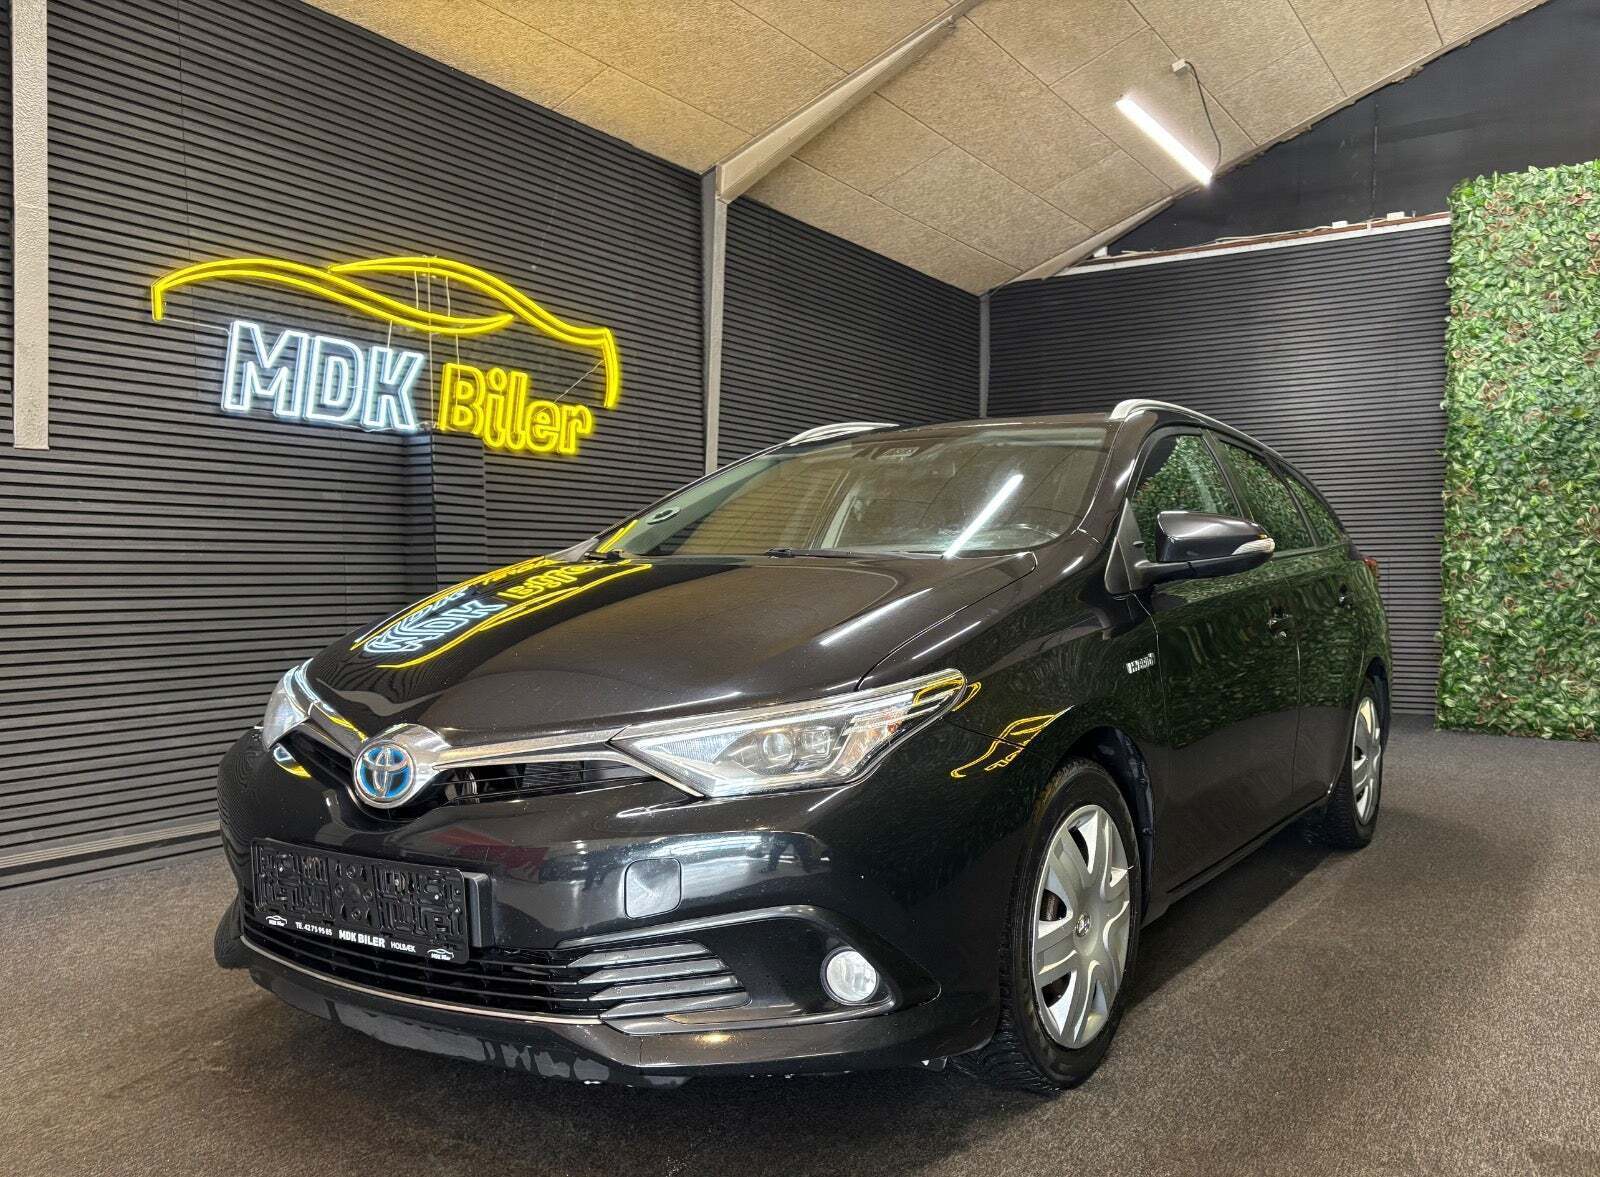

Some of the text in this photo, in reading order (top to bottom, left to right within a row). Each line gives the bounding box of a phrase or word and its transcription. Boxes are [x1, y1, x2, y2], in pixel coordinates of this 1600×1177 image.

[221, 319, 594, 456] MDK Biler
[338, 929, 357, 943] MDK
[357, 933, 386, 949] BILER
